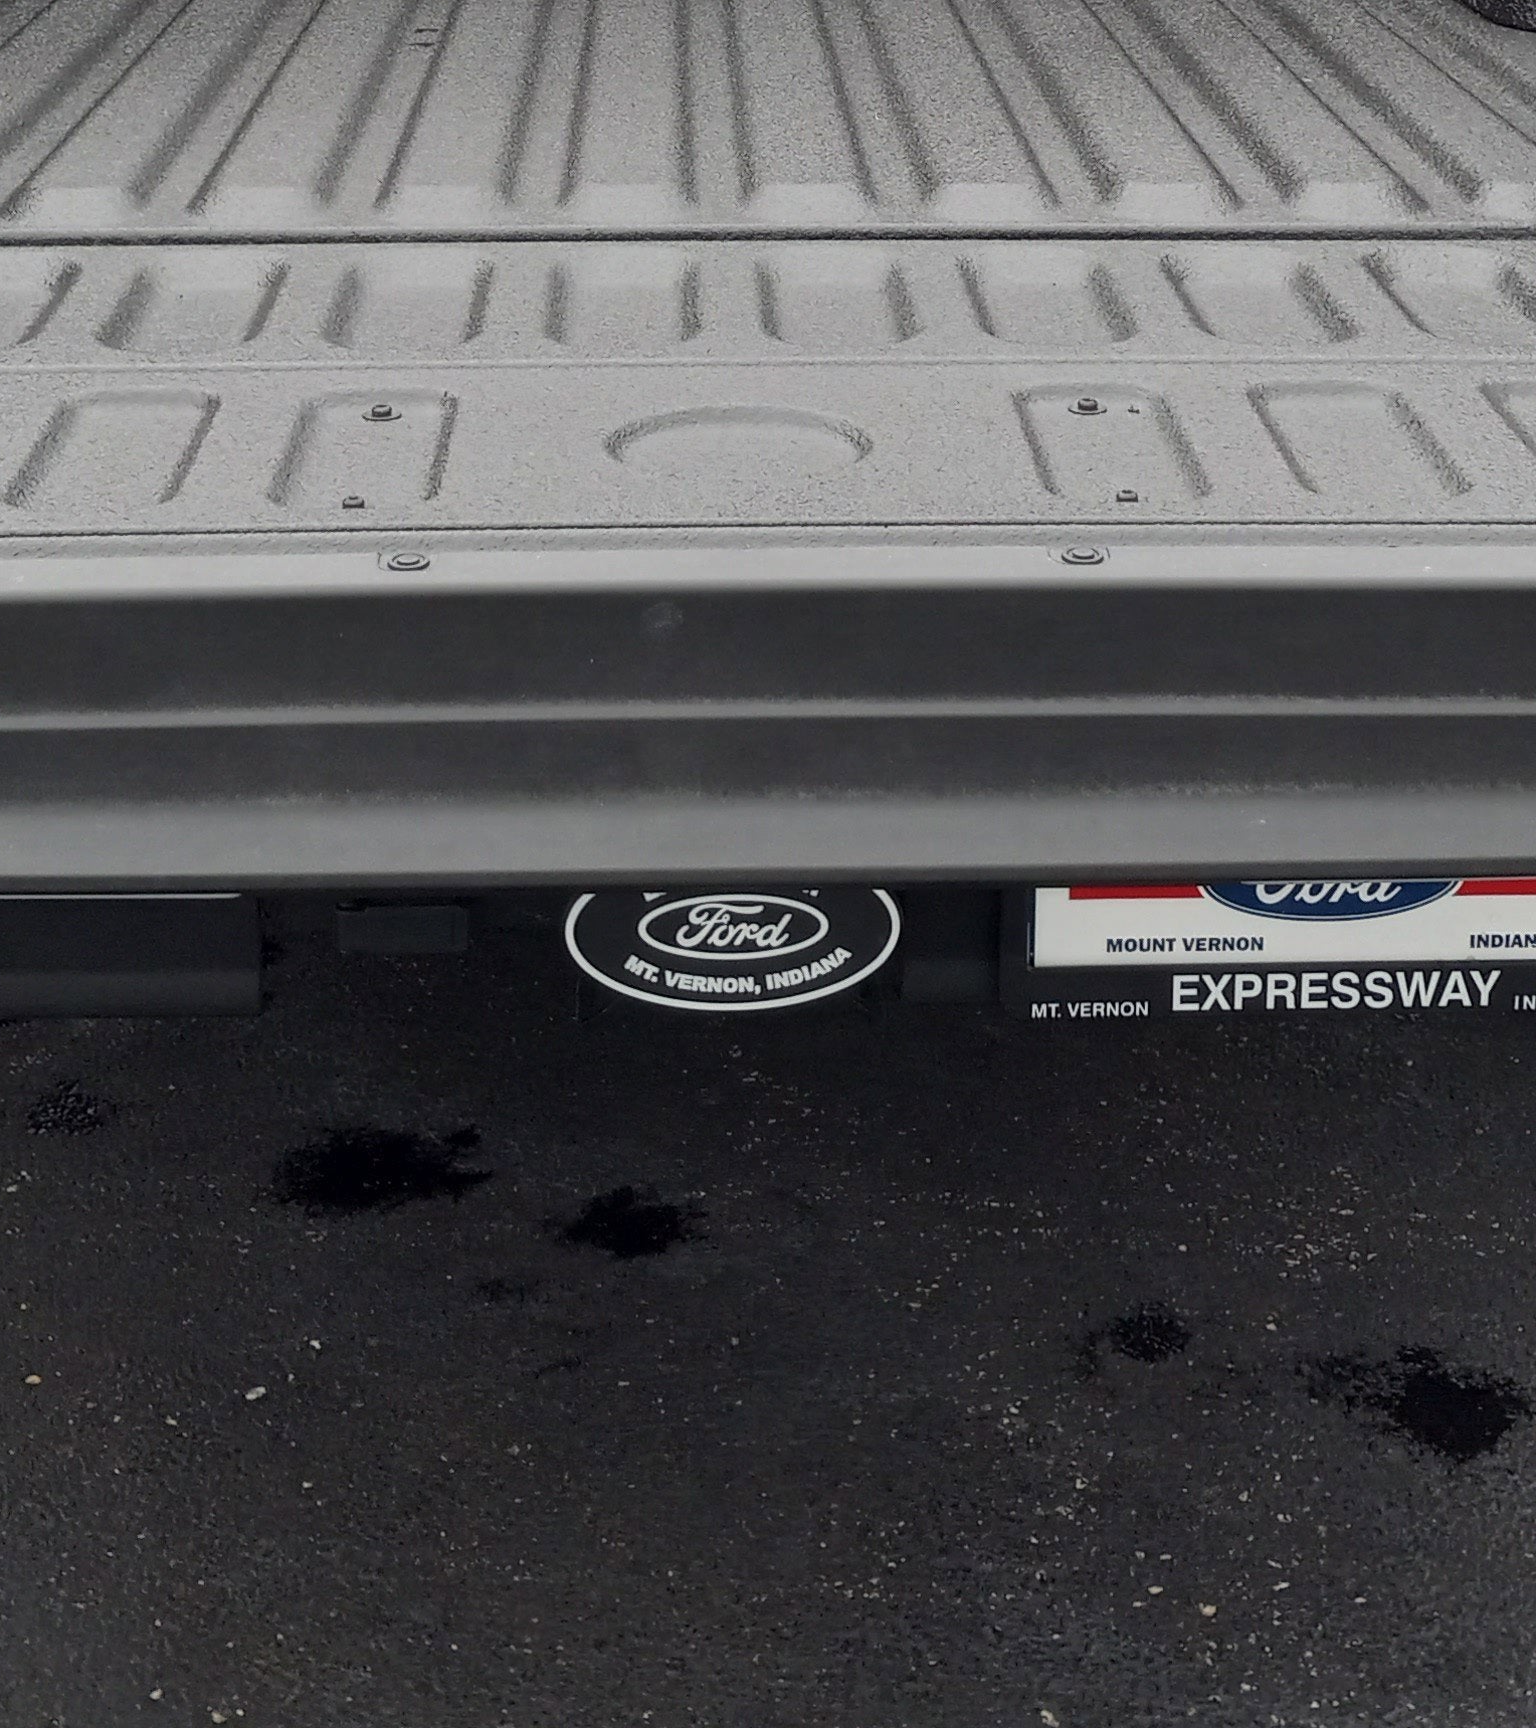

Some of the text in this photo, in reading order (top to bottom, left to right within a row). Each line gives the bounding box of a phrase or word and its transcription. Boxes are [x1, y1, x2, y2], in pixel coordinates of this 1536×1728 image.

[675, 903, 793, 948] Ford
[1106, 936, 1264, 953] MOUNT VERNON
[623, 947, 853, 995] MT. VERNON, INDIANA
[1031, 1003, 1062, 1019] MT.
[1067, 1001, 1150, 1018] VERNON
[1172, 970, 1502, 1012] EXPRESSWAY
